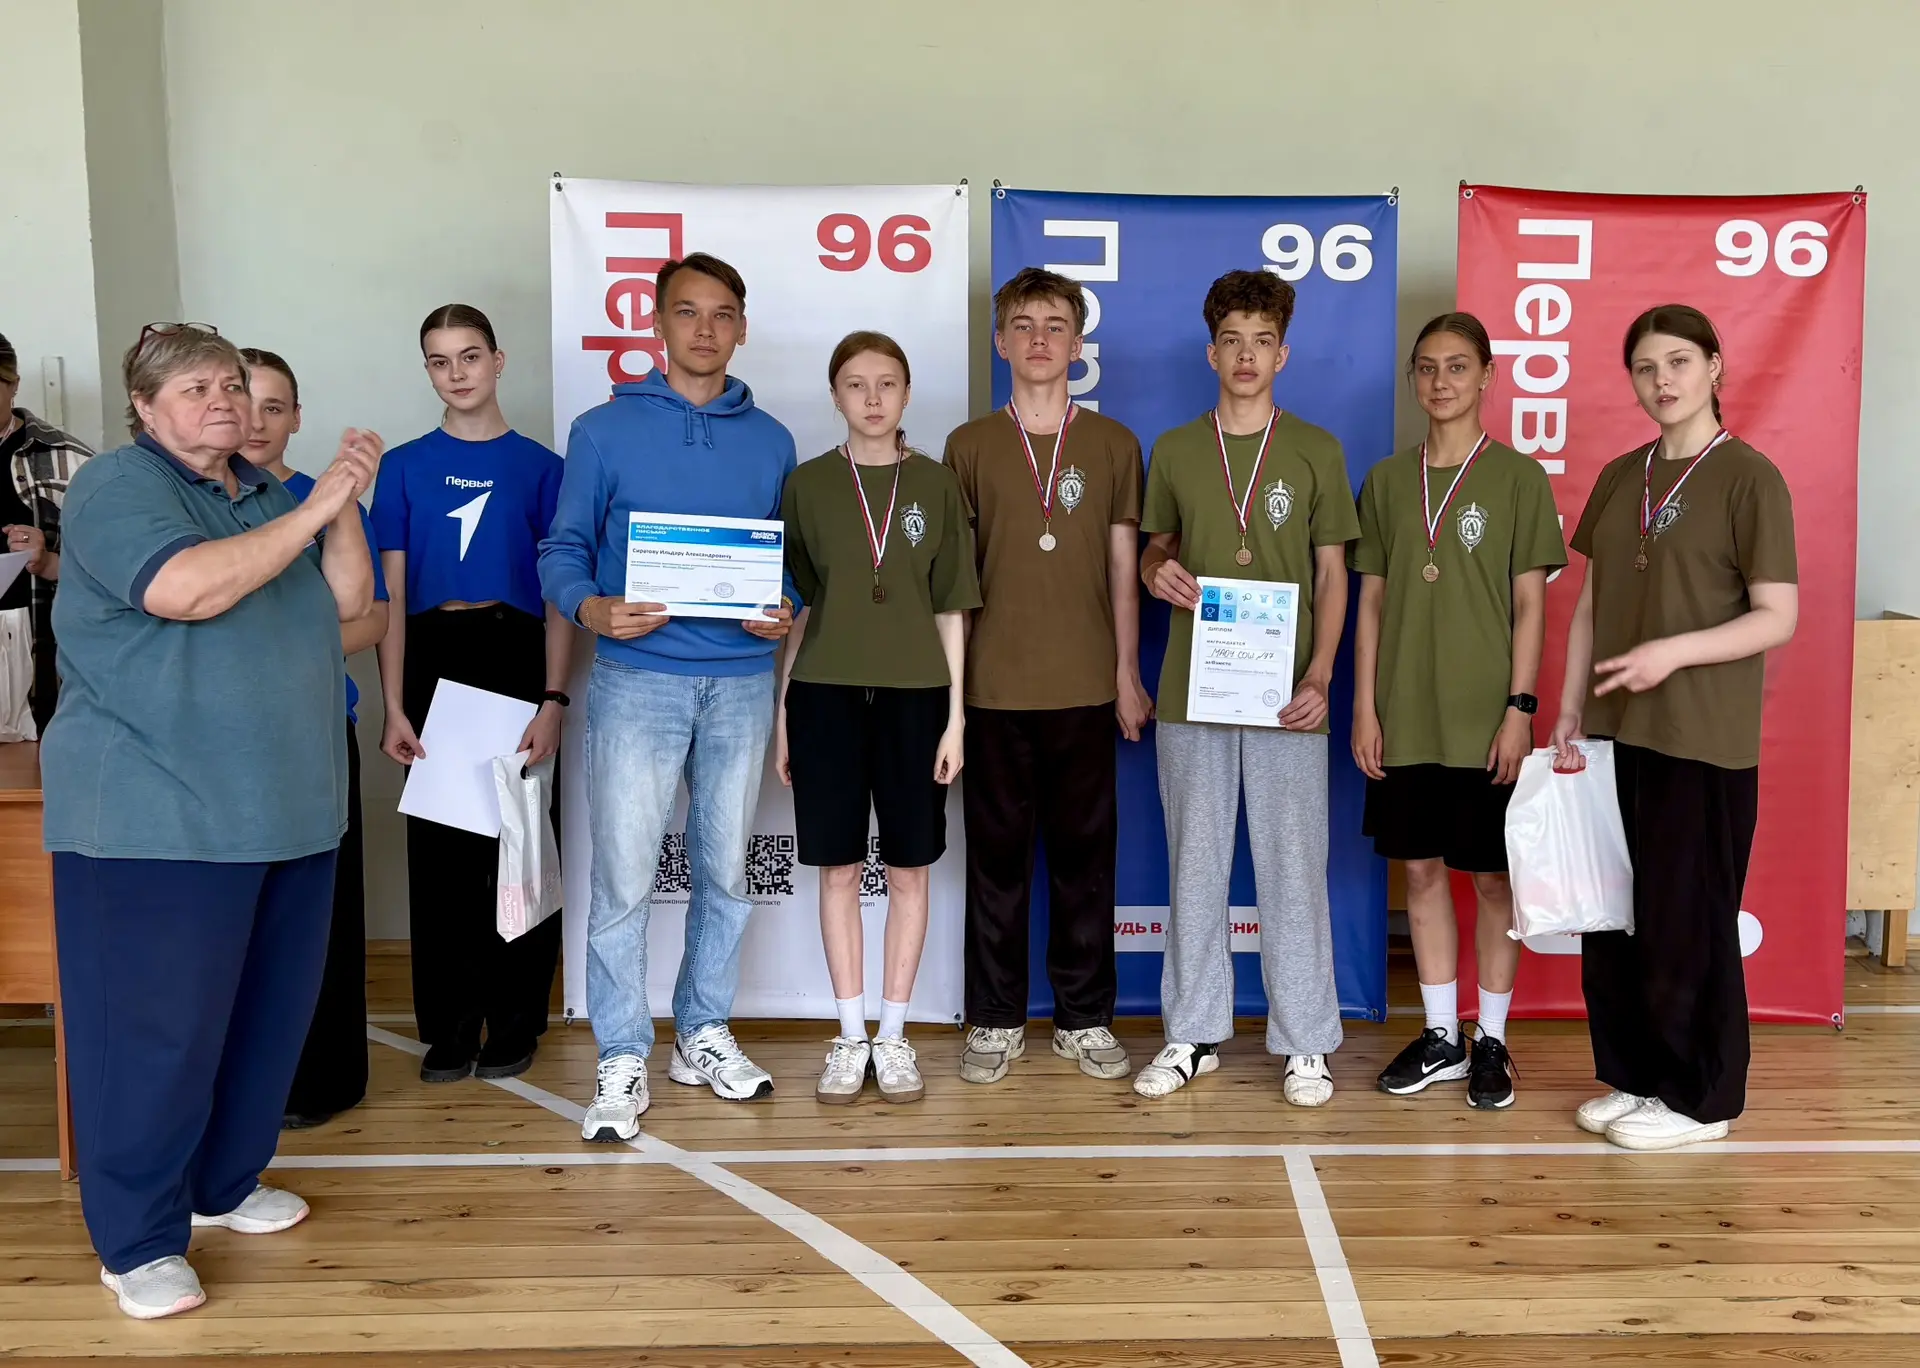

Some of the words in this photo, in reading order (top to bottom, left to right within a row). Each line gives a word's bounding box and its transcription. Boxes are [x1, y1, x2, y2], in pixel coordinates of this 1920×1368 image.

[816, 213, 933, 273] 96
[1261, 222, 1374, 282] 96
[1714, 219, 1830, 278] 96
[445, 475, 494, 490] Первые
[1114, 922, 1147, 936] УДЬ
[1151, 922, 1163, 934] В
